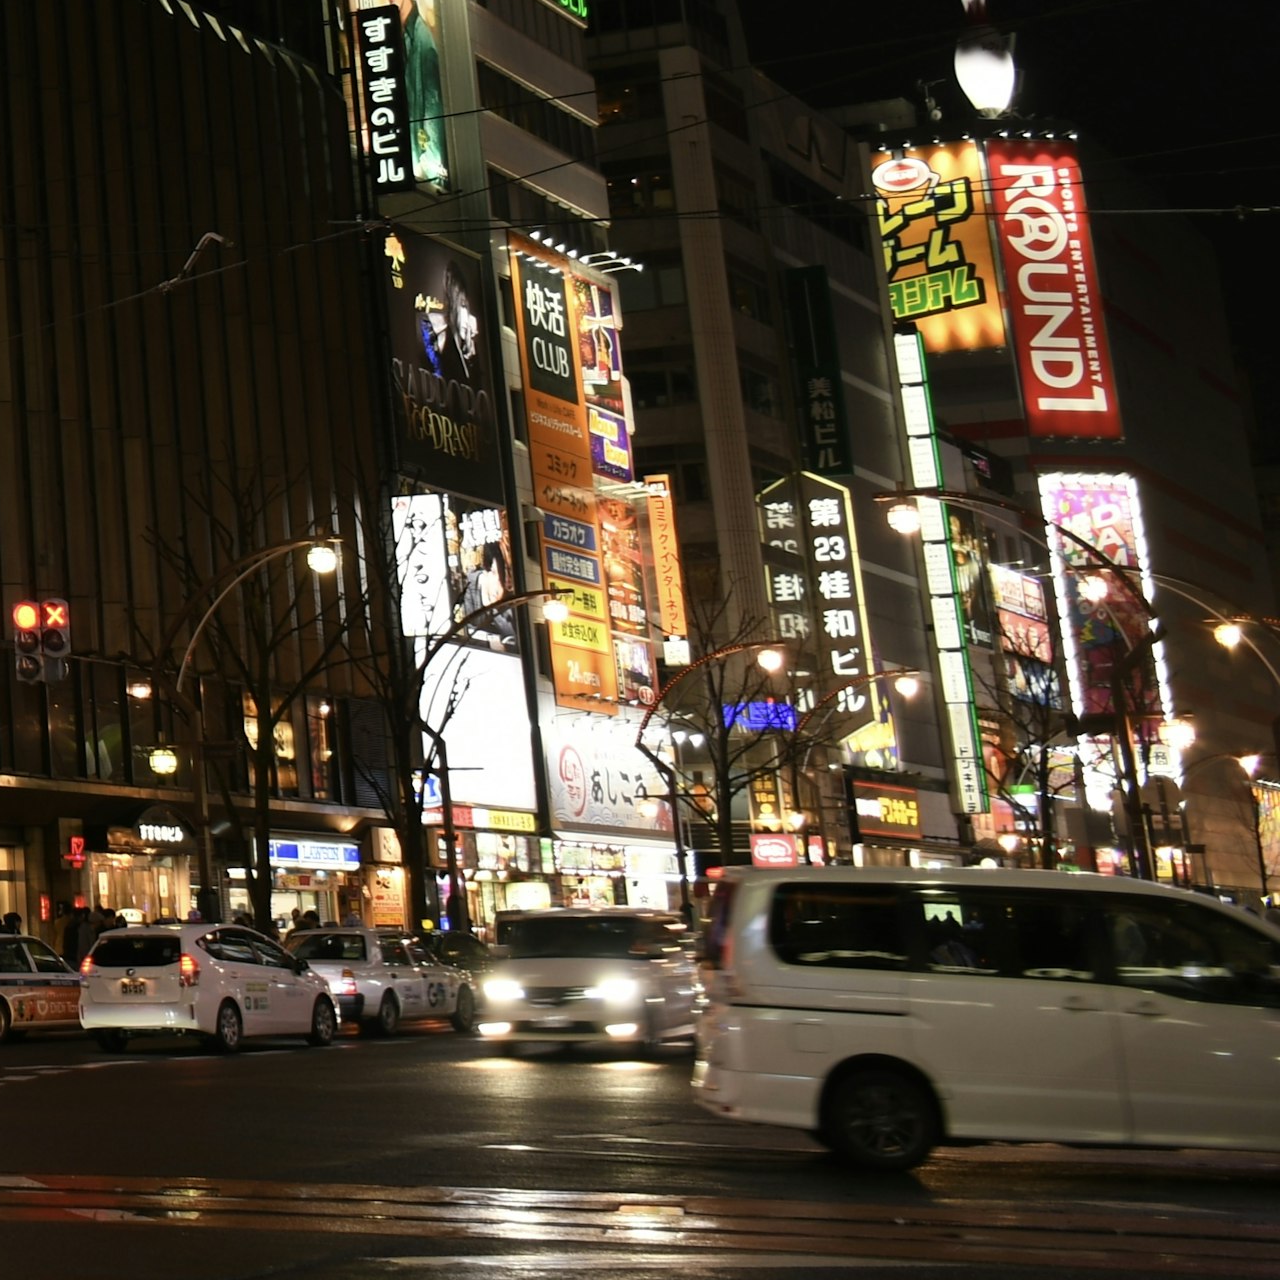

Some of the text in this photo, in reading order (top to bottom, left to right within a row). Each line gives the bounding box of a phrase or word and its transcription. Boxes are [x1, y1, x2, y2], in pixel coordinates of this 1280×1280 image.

[362, 15, 405, 185] すすきのビル
[525, 279, 565, 338] 快活
[531, 336, 571, 379] CLUB
[1000, 164, 1108, 413] ROUND1
[1057, 167, 1103, 384] SPORTS ENTERTAINMENT
[552, 519, 586, 545] カラオケ
[808, 498, 866, 713] 第23桂和ビル
